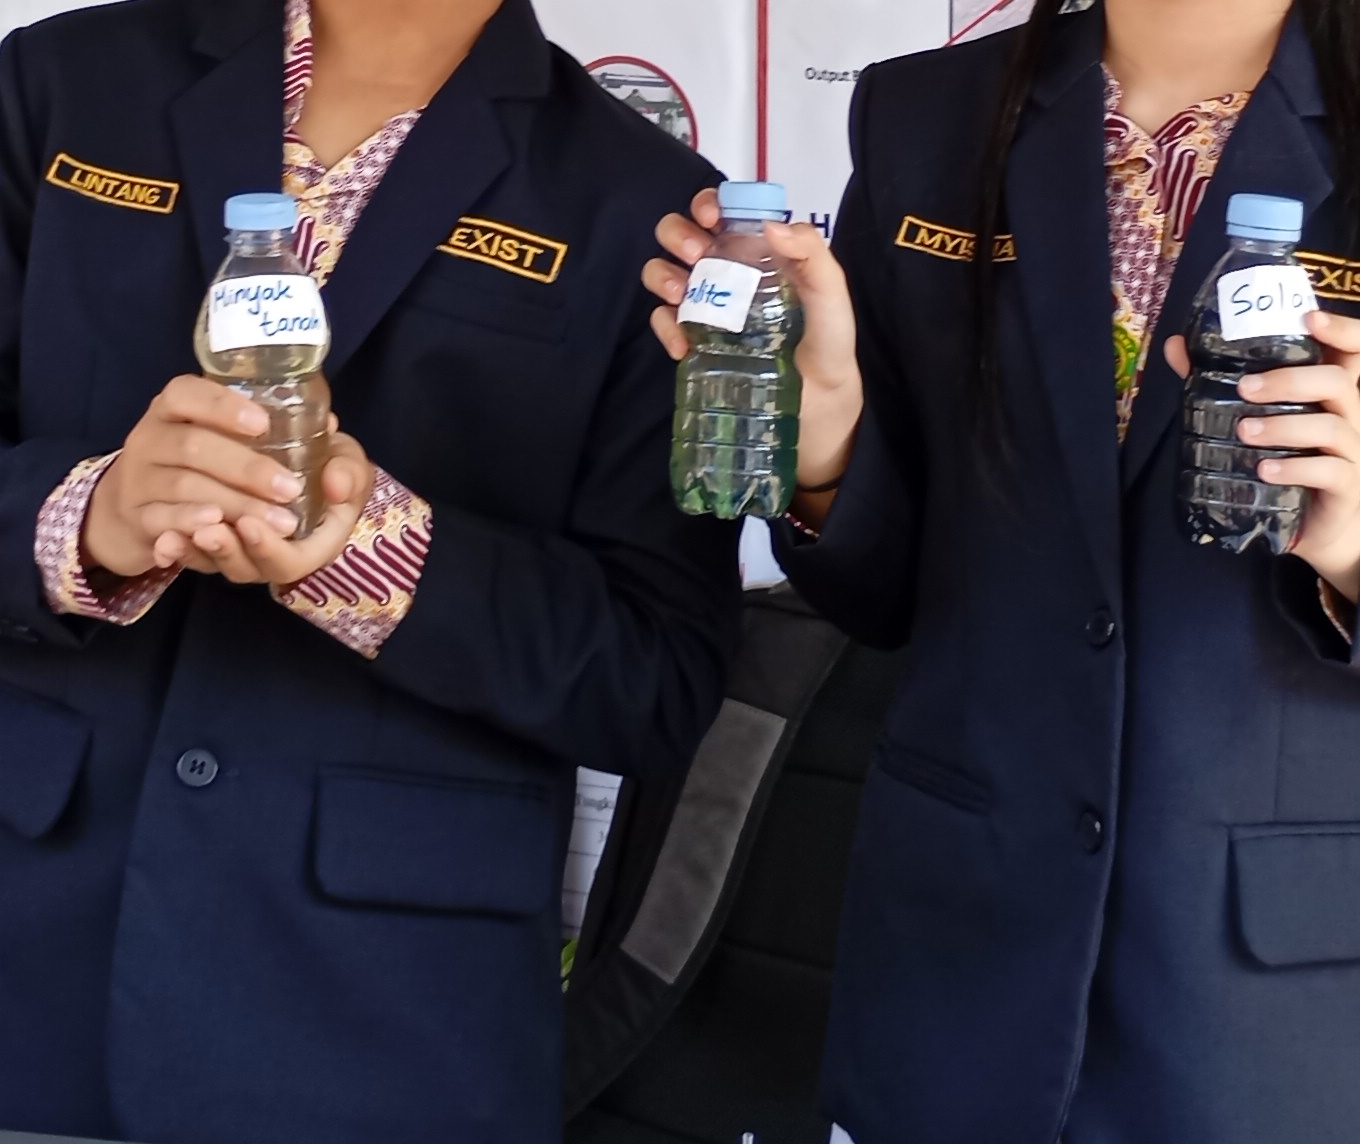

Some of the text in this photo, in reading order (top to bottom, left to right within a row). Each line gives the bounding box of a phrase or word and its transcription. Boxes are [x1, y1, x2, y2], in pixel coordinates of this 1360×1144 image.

[805, 67, 850, 83] Output
[70, 168, 161, 206] LINTANG
[448, 227, 545, 271] EXIST
